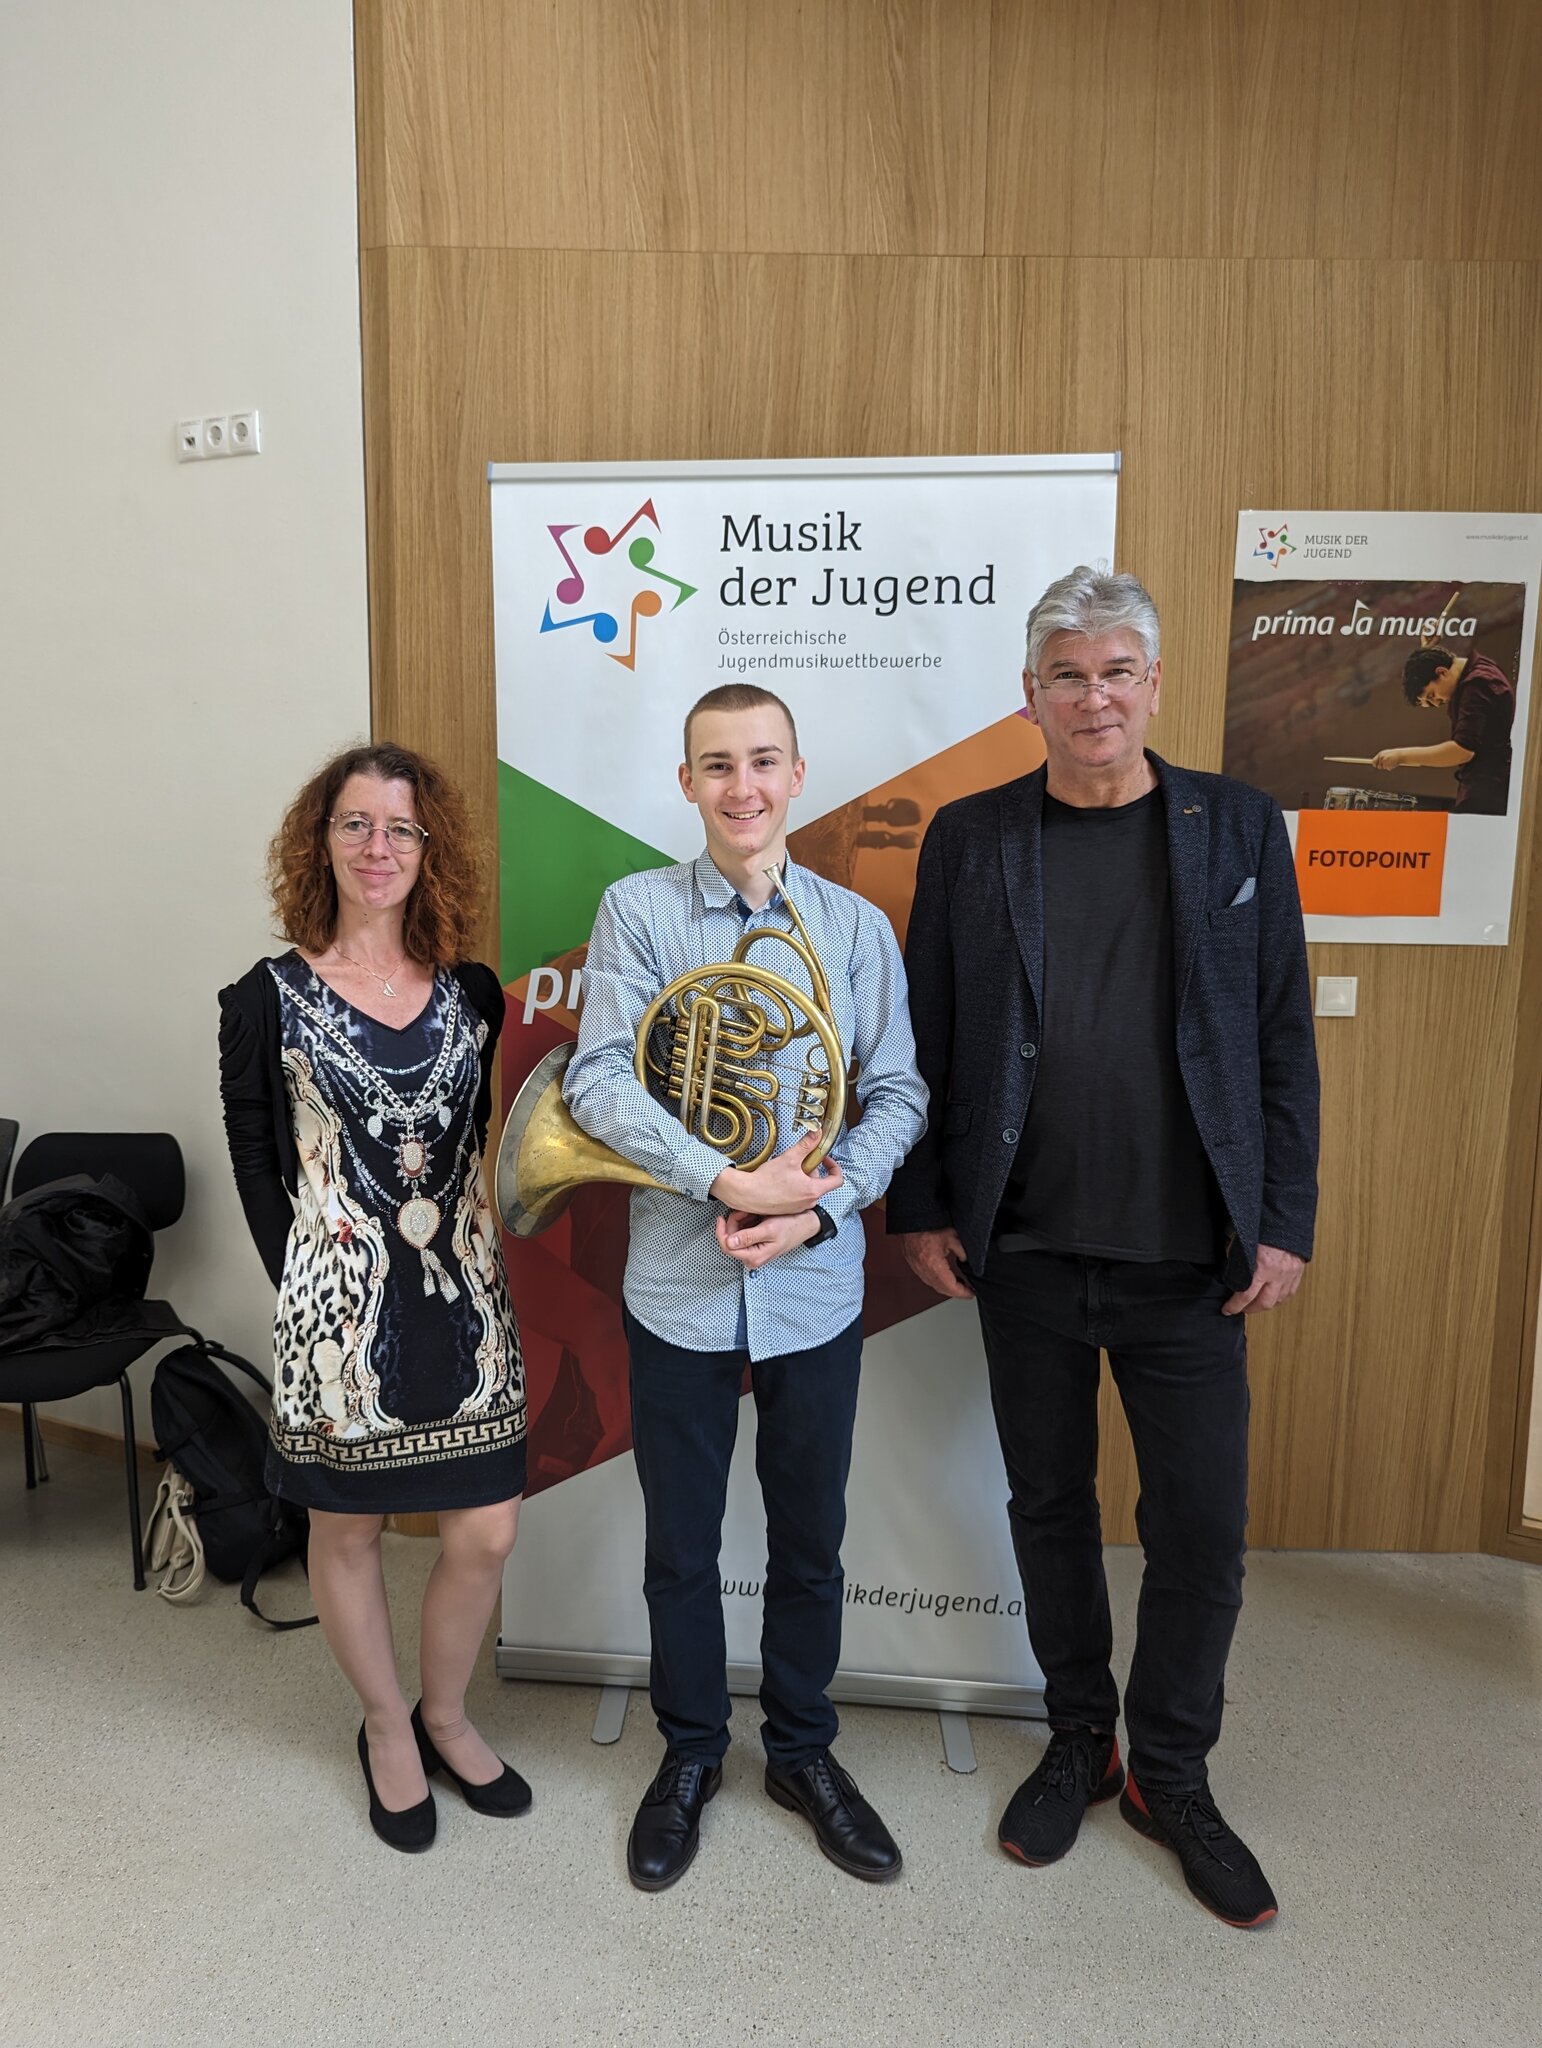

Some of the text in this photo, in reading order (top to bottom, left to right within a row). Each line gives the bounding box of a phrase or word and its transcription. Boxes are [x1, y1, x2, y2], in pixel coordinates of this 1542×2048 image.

[720, 511, 862, 552] Musik
[1304, 535, 1368, 545] MUSIK DER
[1303, 548, 1352, 559] JUGEND
[719, 564, 996, 617] der Jugend
[1251, 609, 1335, 641] prima
[1378, 610, 1477, 636] musica
[718, 626, 847, 646] Österreichische
[717, 652, 943, 673] Jugendmusikwettbewerbe
[1308, 850, 1431, 869] FOTOPOINT
